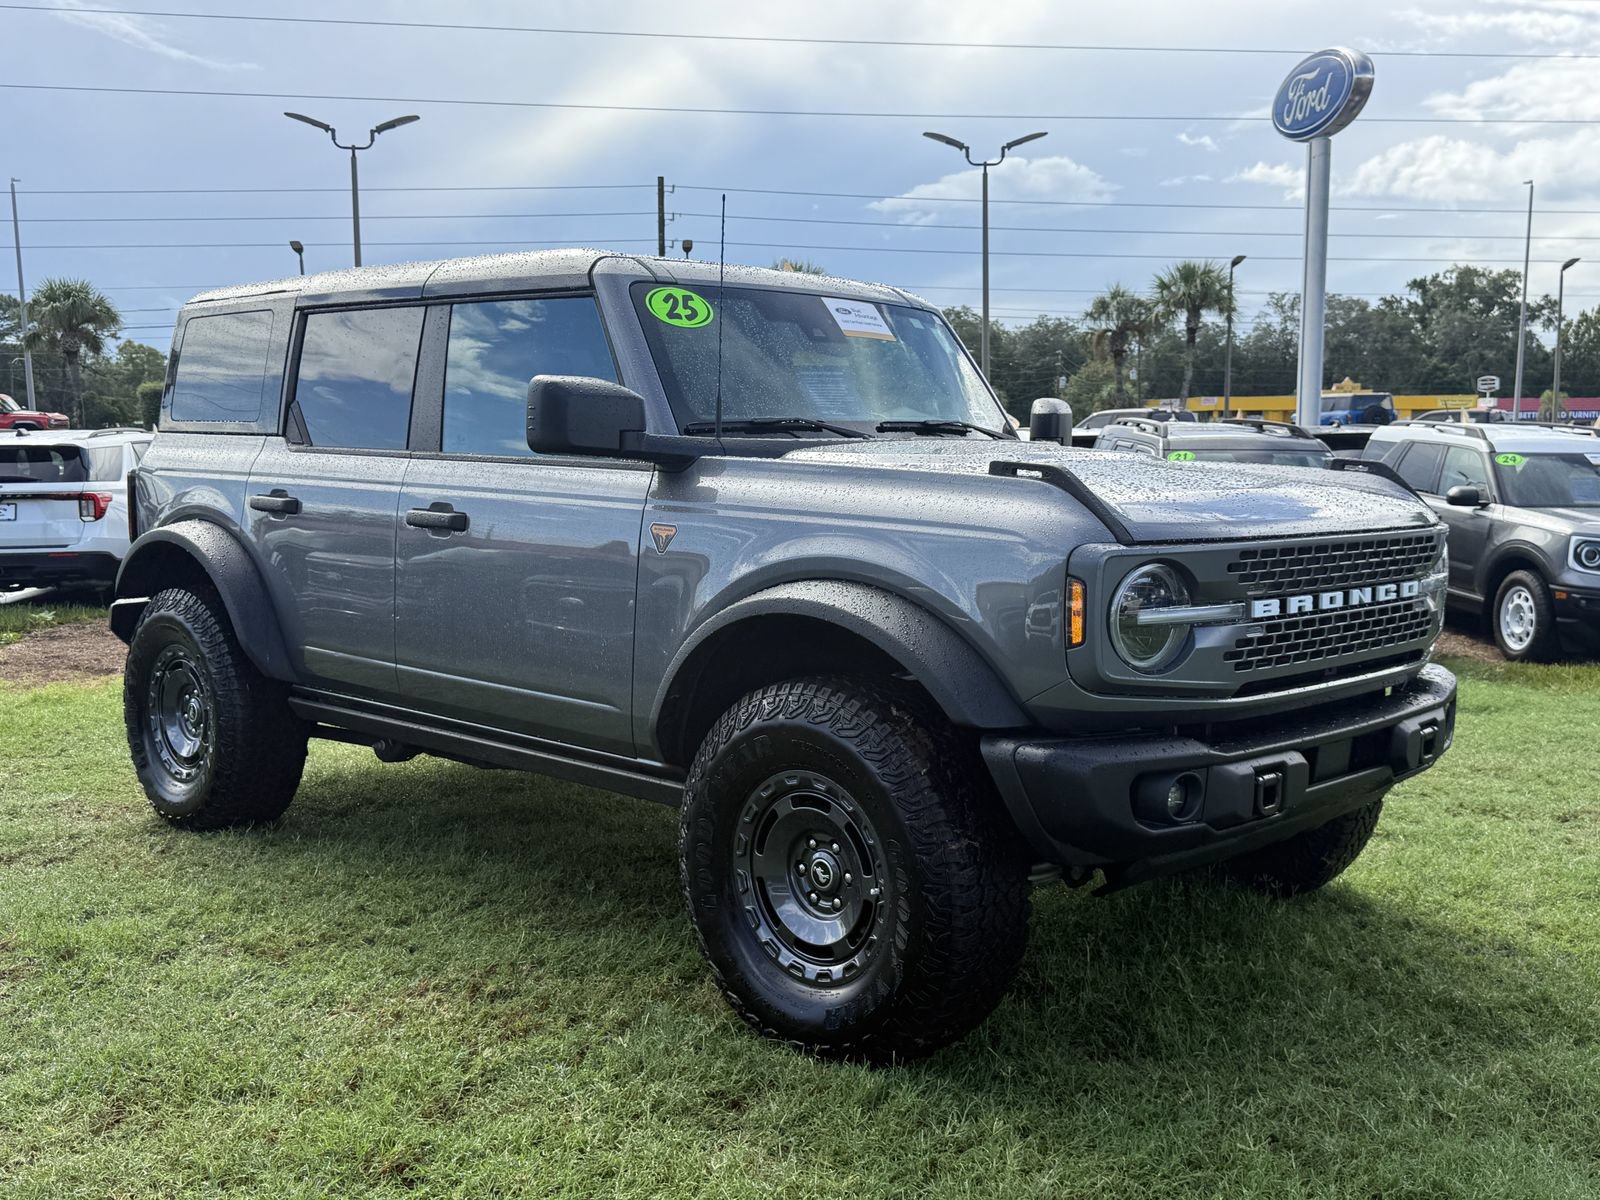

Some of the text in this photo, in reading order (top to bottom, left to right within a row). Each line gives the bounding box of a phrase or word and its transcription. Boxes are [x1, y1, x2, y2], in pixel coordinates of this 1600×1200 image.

[1283, 67, 1333, 127] Ford
[663, 293, 698, 321] 25
[1251, 580, 1419, 618] BRONCO
